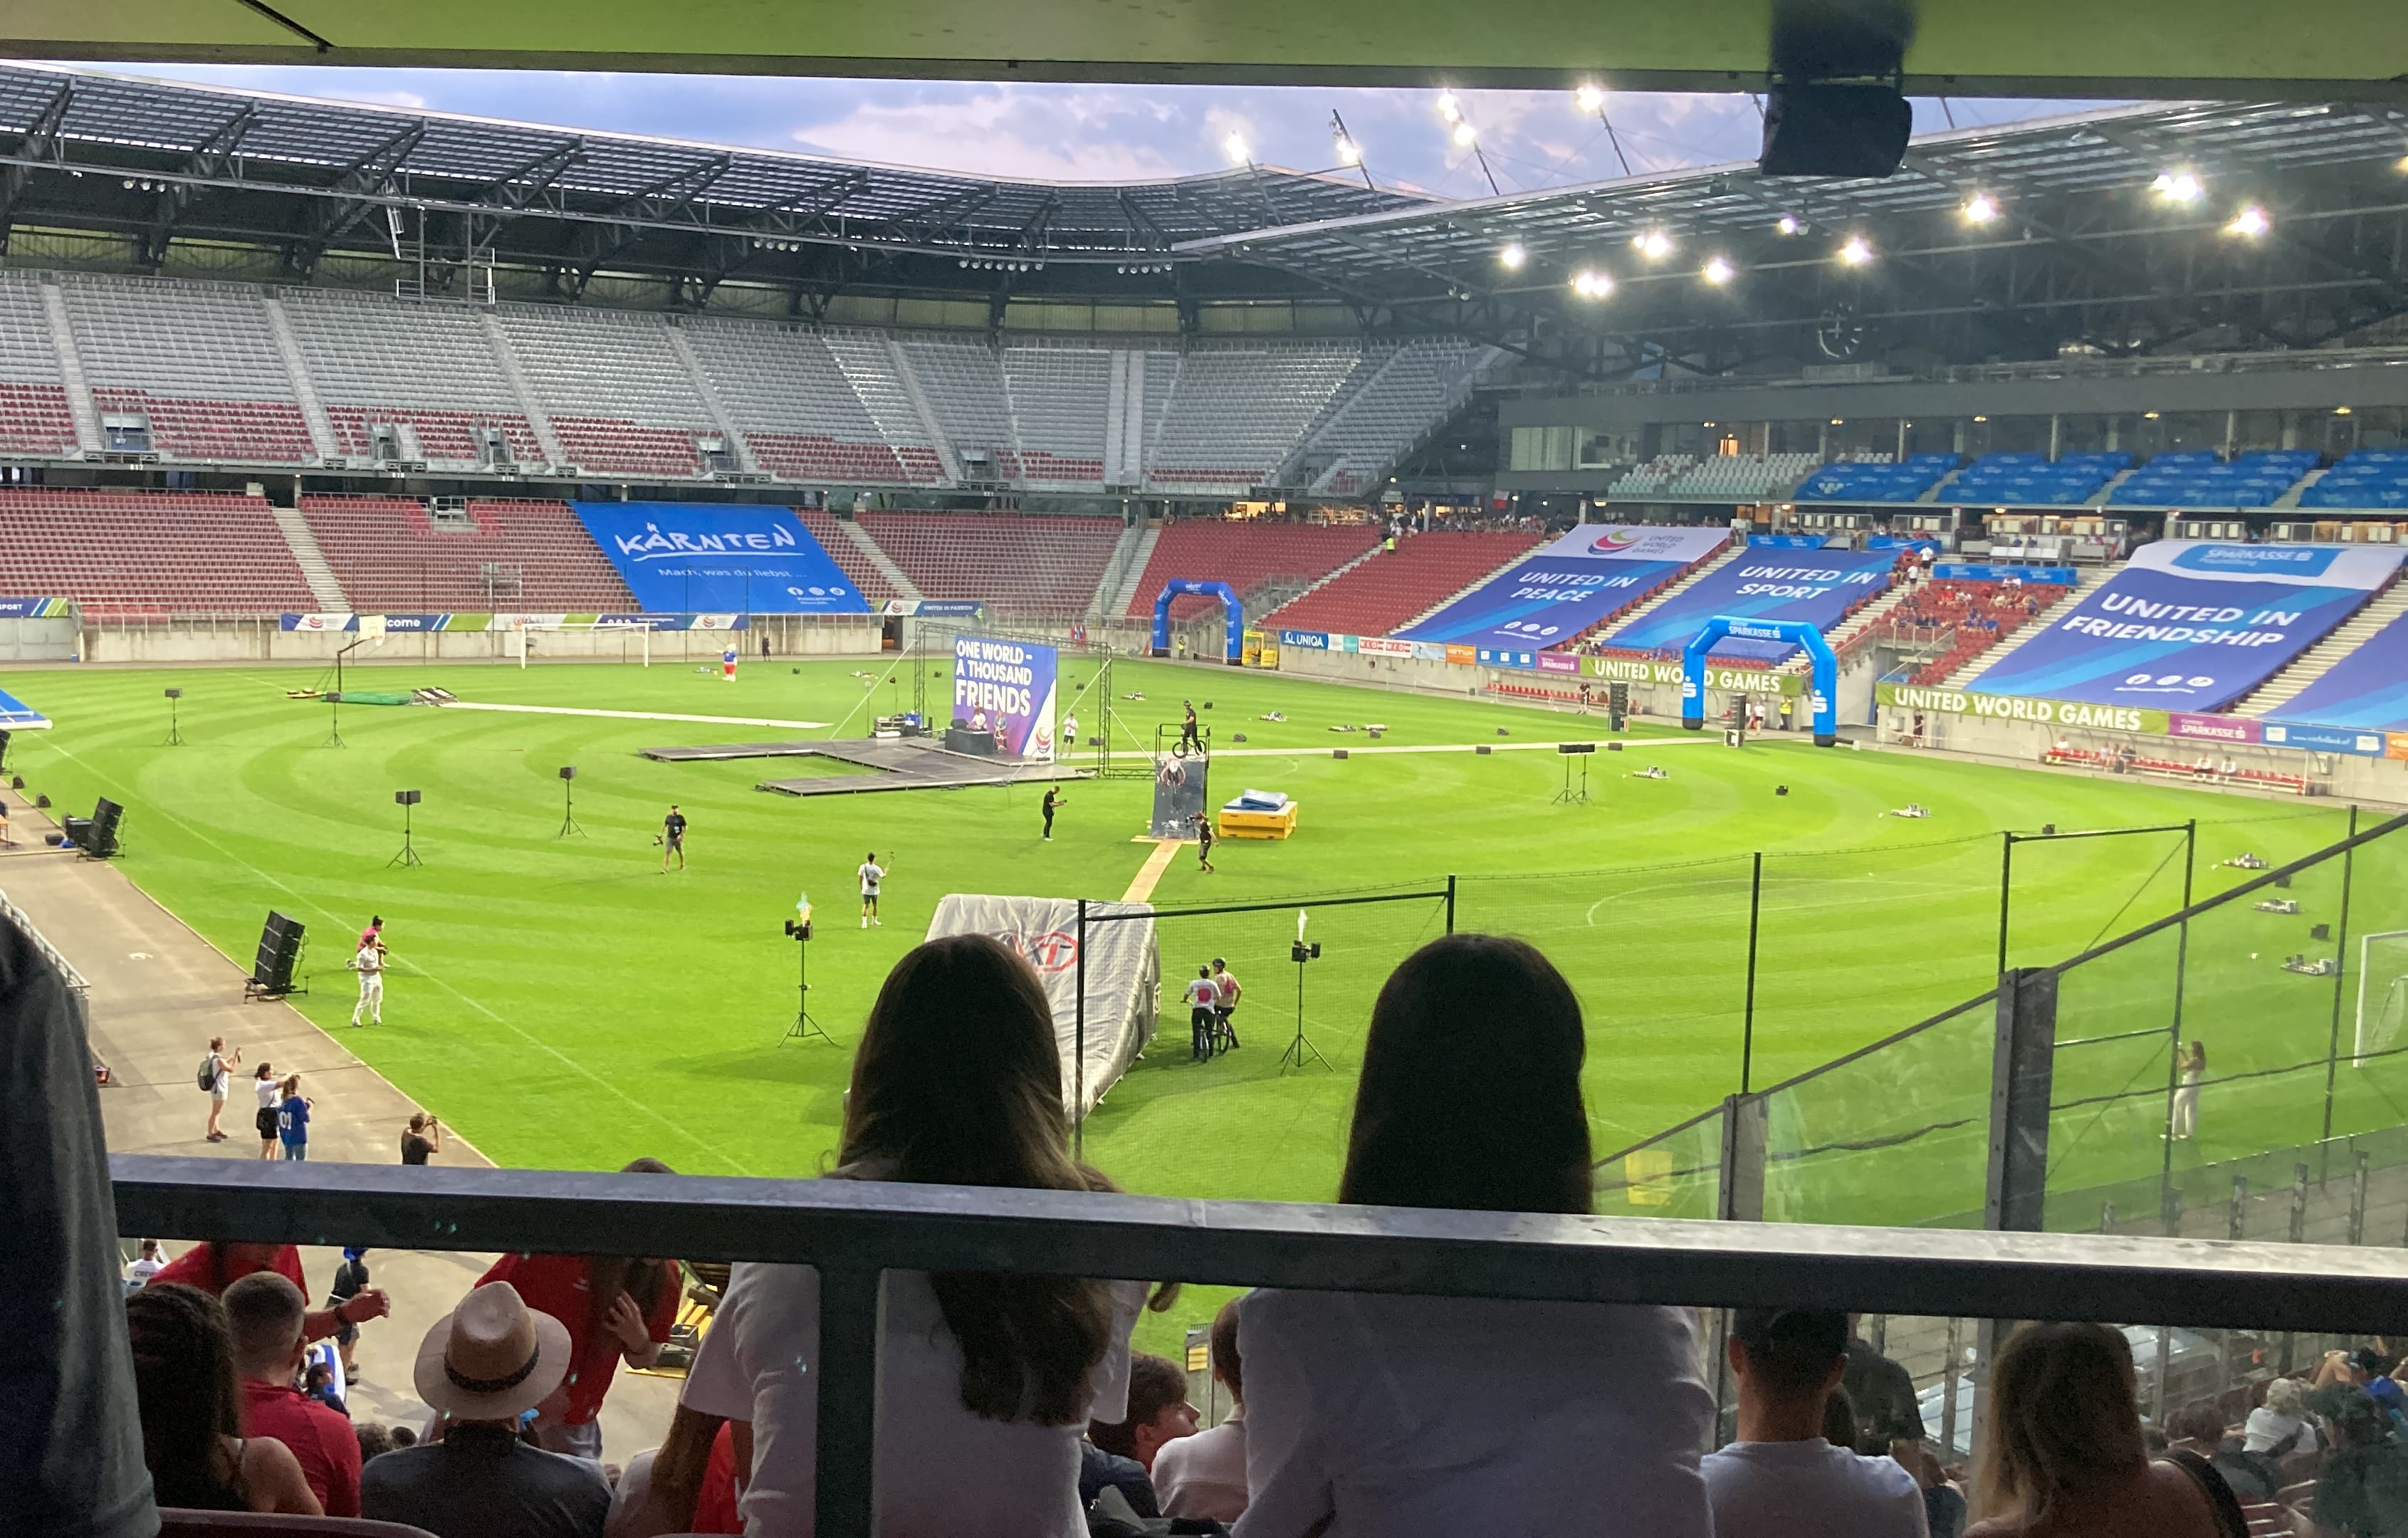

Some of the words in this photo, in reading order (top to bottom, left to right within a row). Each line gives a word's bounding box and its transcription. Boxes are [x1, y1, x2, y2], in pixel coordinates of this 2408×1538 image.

[615, 522, 796, 555] KÄRNTEN
[2205, 549, 2296, 561] SPARKASSE
[1518, 572, 1605, 585] UNITED
[1603, 577, 1640, 588] IN
[1739, 566, 1841, 582] UNITED
[1841, 572, 1877, 585] IN
[1510, 587, 1593, 602] PEACE
[1735, 583, 1833, 599] SPORT
[2101, 593, 2244, 623] UNITED
[2248, 610, 2301, 627] IN
[1296, 634, 1324, 647] UNIQA
[1728, 626, 1772, 638] SPARKASSE
[2062, 616, 2285, 647] FRIENDSHIP
[956, 639, 980, 659] ONE
[982, 643, 1024, 664] WORLD
[956, 659, 965, 676] A
[968, 659, 1032, 686] THOUSAND
[1594, 659, 1649, 680] UNITED
[1654, 665, 1715, 686] WOD
[1719, 671, 1780, 692] GAMES
[956, 679, 1031, 717] FRIENDS
[1895, 688, 1967, 711] UNITED
[1972, 695, 2051, 721] WORLD
[2058, 704, 2141, 731] GAMES
[2181, 724, 2234, 738] SPARKASSE
